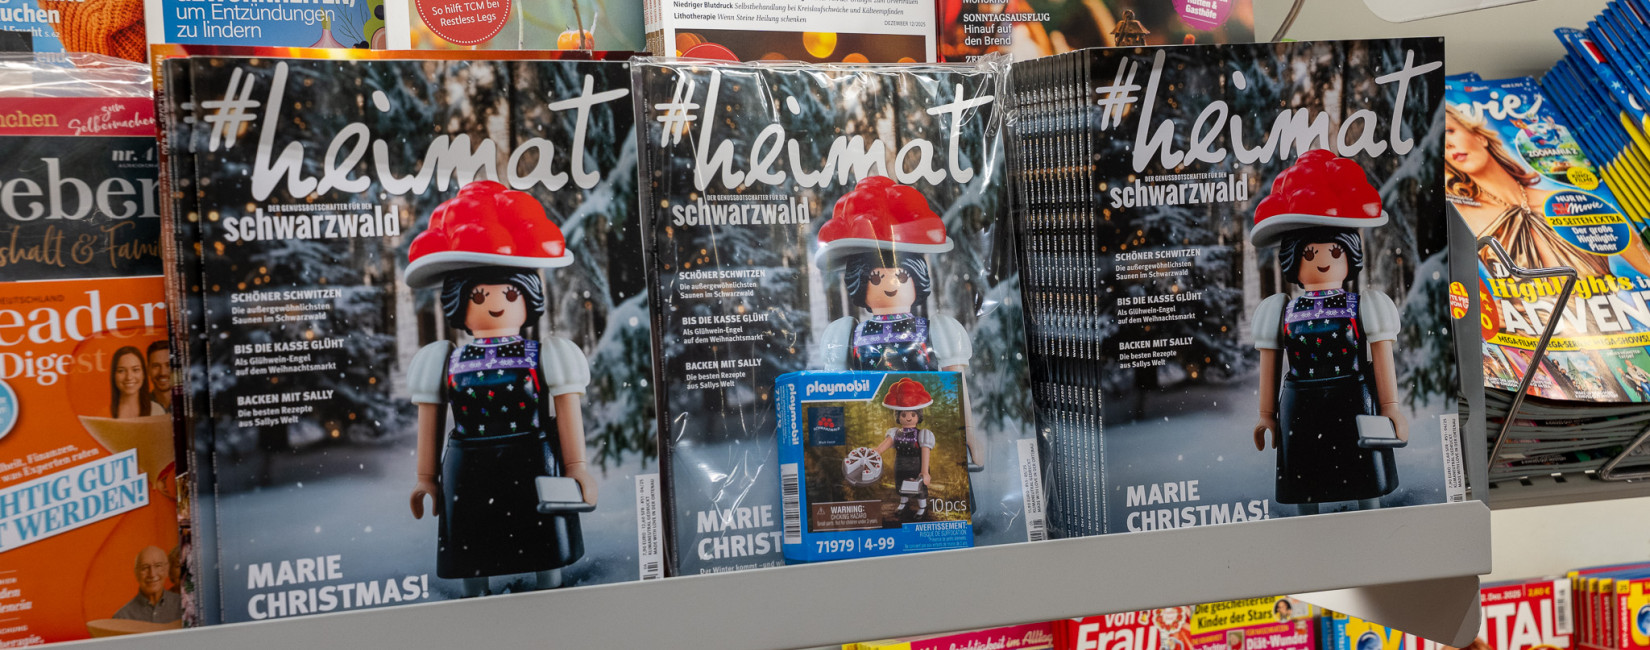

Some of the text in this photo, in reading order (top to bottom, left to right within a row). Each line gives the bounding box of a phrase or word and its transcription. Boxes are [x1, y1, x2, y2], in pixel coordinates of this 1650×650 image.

[176, 2, 335, 26] um Entzündungen
[431, 1, 485, 16] So hilft TCM
[673, 1, 703, 9] Niedriger
[734, 3, 786, 12] Selbstbehandlung
[797, 4, 849, 14] Kreislaufschwäche
[862, 7, 904, 16] Kälteempfinden
[1185, 4, 1217, 19] Gasthöfe
[440, 13, 497, 27] Restless Legs
[673, 13, 716, 21] Lithotherapie
[756, 15, 779, 23] Heilung
[963, 13, 1050, 22] SONNTAGSAUSFLUG
[176, 21, 262, 38] zu lindern
[964, 23, 1012, 34] Hinauf auf
[964, 35, 1011, 46] den Brend
[101, 103, 126, 122] zum
[1095, 49, 1443, 173] #heimat
[201, 61, 630, 201] #heimat
[654, 69, 994, 192] #heimat
[112, 149, 138, 162] nr.
[1155, 173, 1208, 182] GENUSSBOTSCHAFTER
[1110, 173, 1248, 209] schwarzwald
[1555, 194, 1588, 203] NUR IN
[267, 202, 372, 212] DER GENUSSBOTSCHAFTER FÜR DEN
[672, 196, 810, 227] schwarzwald
[1567, 201, 1604, 214] Movie
[222, 204, 400, 242] schwarzwald
[1550, 215, 1624, 225] 20 SEITEN EXTRA
[1571, 225, 1614, 235] Der große
[71, 233, 98, 265] &
[1589, 241, 1618, 252] Planer
[1115, 248, 1200, 262] SCHÖNER SCHWITZEN
[1127, 261, 1191, 271] außergewöhnlichsten
[1148, 269, 1188, 278] Schwarzwald
[679, 269, 766, 280] SCHÖNER SCHWITZEN
[231, 289, 342, 303] SCHÖNER SCHWITZEN
[1486, 273, 1634, 304] Highlghts
[1117, 291, 1202, 306] BIS DIE KASSE GLÜHT
[231, 303, 330, 314] Die außergewöhnlichsten
[1128, 305, 1176, 315] Glühwein-Engel
[0, 289, 166, 347] eader
[232, 312, 326, 324] Saunen im Schwarzwald
[682, 312, 769, 325] BIS DIE KASSE GLÜHT
[1129, 316, 1142, 324] dem
[1142, 312, 1196, 323] Weihnachtsmarkt
[234, 337, 344, 354] BIS DIE KASSE GLÜHT
[1119, 336, 1193, 350] BACKEN MIT SALLY
[0, 348, 107, 386] Digest
[234, 354, 311, 366] Als Glühwein-Engel
[685, 358, 762, 371] BACKEN MIT SALLY
[235, 362, 336, 376] auf dem Weihnachtsmarkt
[806, 379, 870, 397] playmobil
[237, 390, 334, 406] BACKEN MIT SALLY
[237, 405, 313, 417] Die besten Rezepte
[787, 383, 799, 446] playmobil
[255, 418, 279, 427] Sallys
[280, 416, 298, 424] Welt
[23, 447, 99, 475] Experten raten
[26, 444, 78, 464] Finanzen,
[77, 455, 135, 493] GUT
[1126, 480, 1200, 508] MARIE
[14, 478, 145, 541] WERDEN!
[830, 505, 865, 514] WARNING:
[1126, 499, 1270, 533] CHRISTMAS!
[697, 504, 775, 533] MARIE
[697, 530, 783, 561] CHRIST
[816, 538, 855, 554] 71979
[864, 536, 895, 551] 4-99
[247, 554, 343, 590] MARIE
[712, 563, 758, 574] Winter kommt
[247, 574, 430, 620] CHRISTMAS!
[1104, 611, 1135, 628] von
[1197, 610, 1273, 629] Kinder der Stars
[1006, 630, 1053, 648] im Alltag
[1075, 622, 1160, 650] Frau
